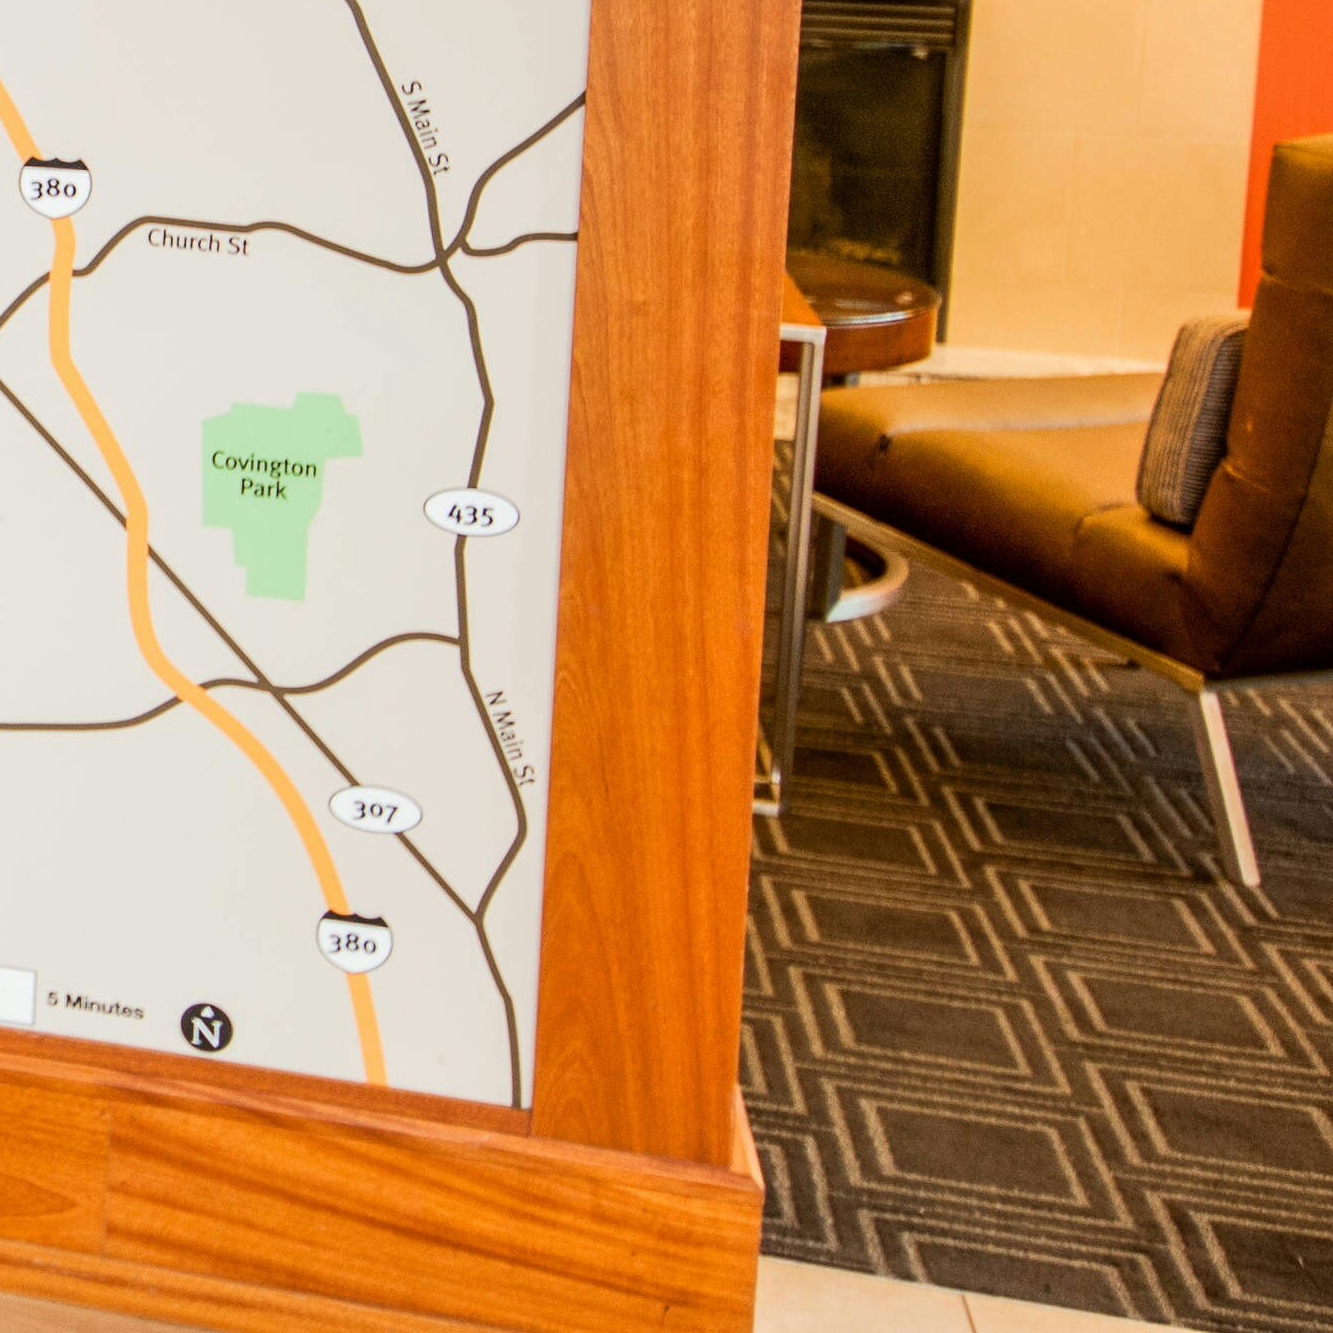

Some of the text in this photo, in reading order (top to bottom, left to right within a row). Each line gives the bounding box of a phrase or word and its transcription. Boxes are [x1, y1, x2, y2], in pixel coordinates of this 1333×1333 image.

[401, 80, 451, 176] S Main St
[30, 178, 78, 200] 380
[147, 228, 250, 256] Church St
[212, 451, 317, 479] Covington
[240, 479, 288, 501] Park
[446, 503, 495, 526] 435
[485, 690, 535, 787] N Main St
[353, 800, 398, 823] 307
[328, 934, 377, 955] 380
[46, 992, 144, 1021] 5 Minutes
[192, 1018, 223, 1049] N
